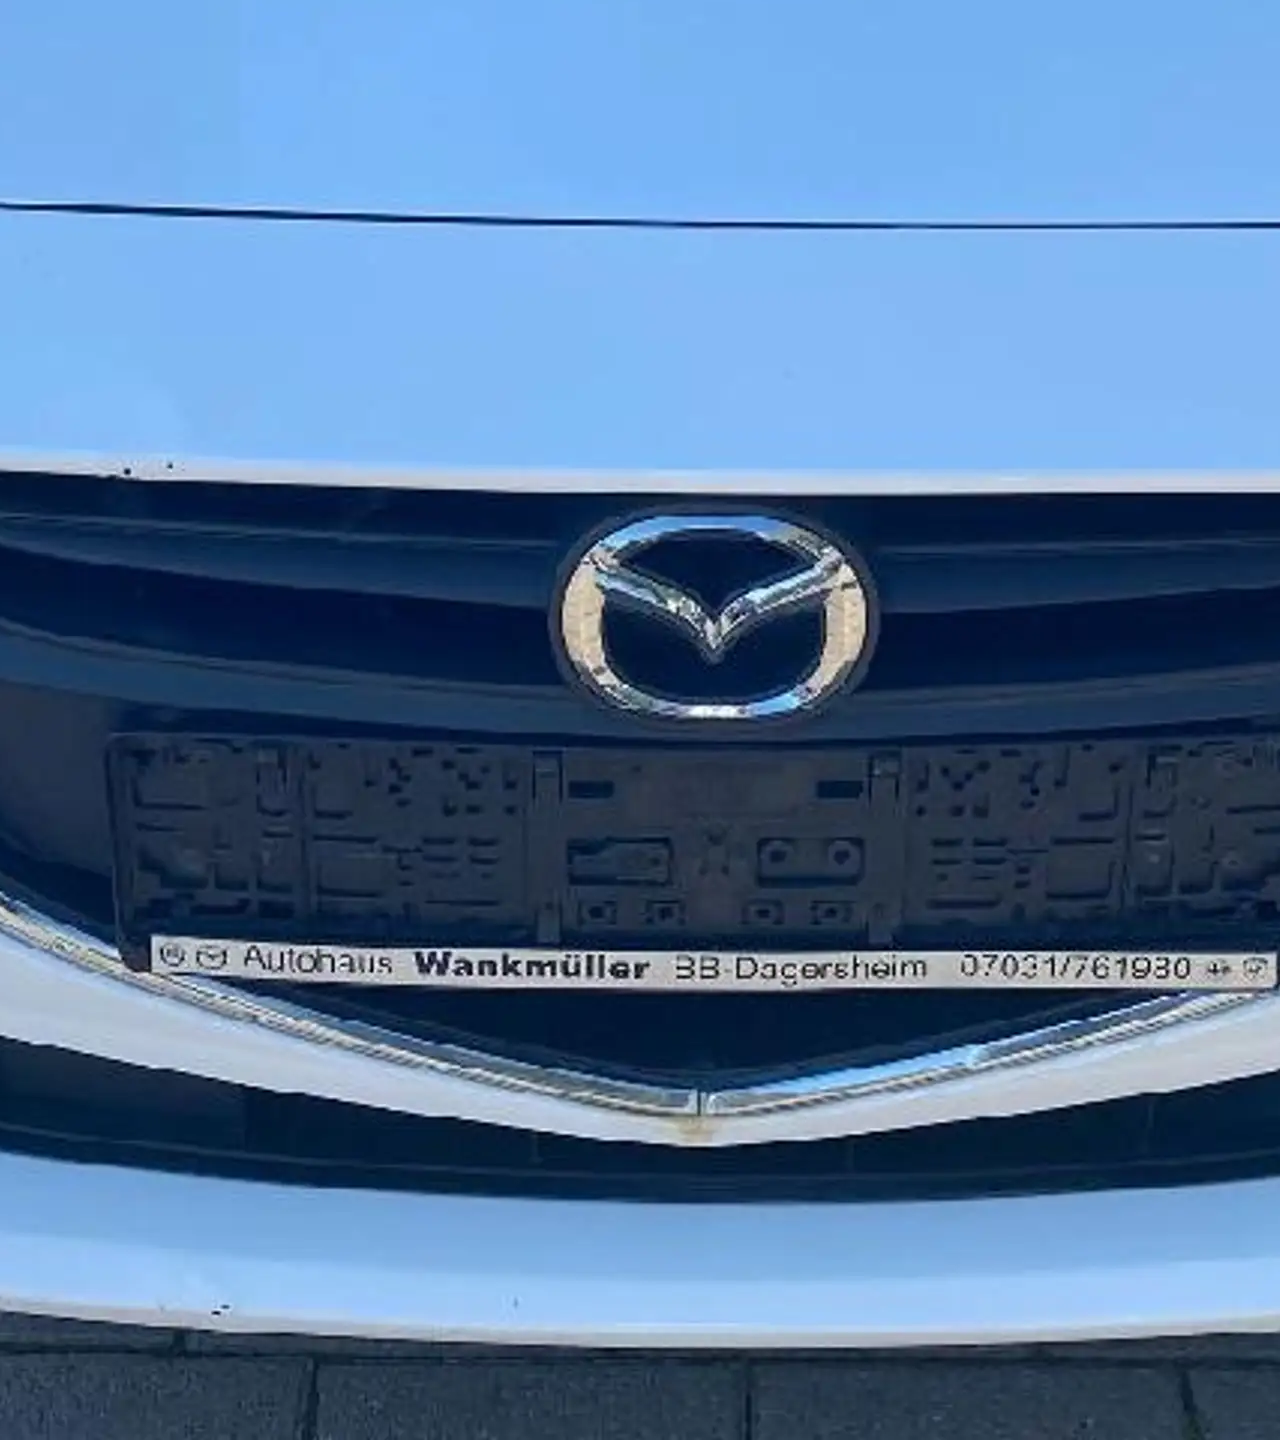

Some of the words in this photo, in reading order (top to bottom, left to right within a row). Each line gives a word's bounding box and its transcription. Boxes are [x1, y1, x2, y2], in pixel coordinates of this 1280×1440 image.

[243, 944, 394, 975] Autohaus
[412, 950, 652, 980] Wankmüller
[675, 953, 928, 988] BB-Dagersheim
